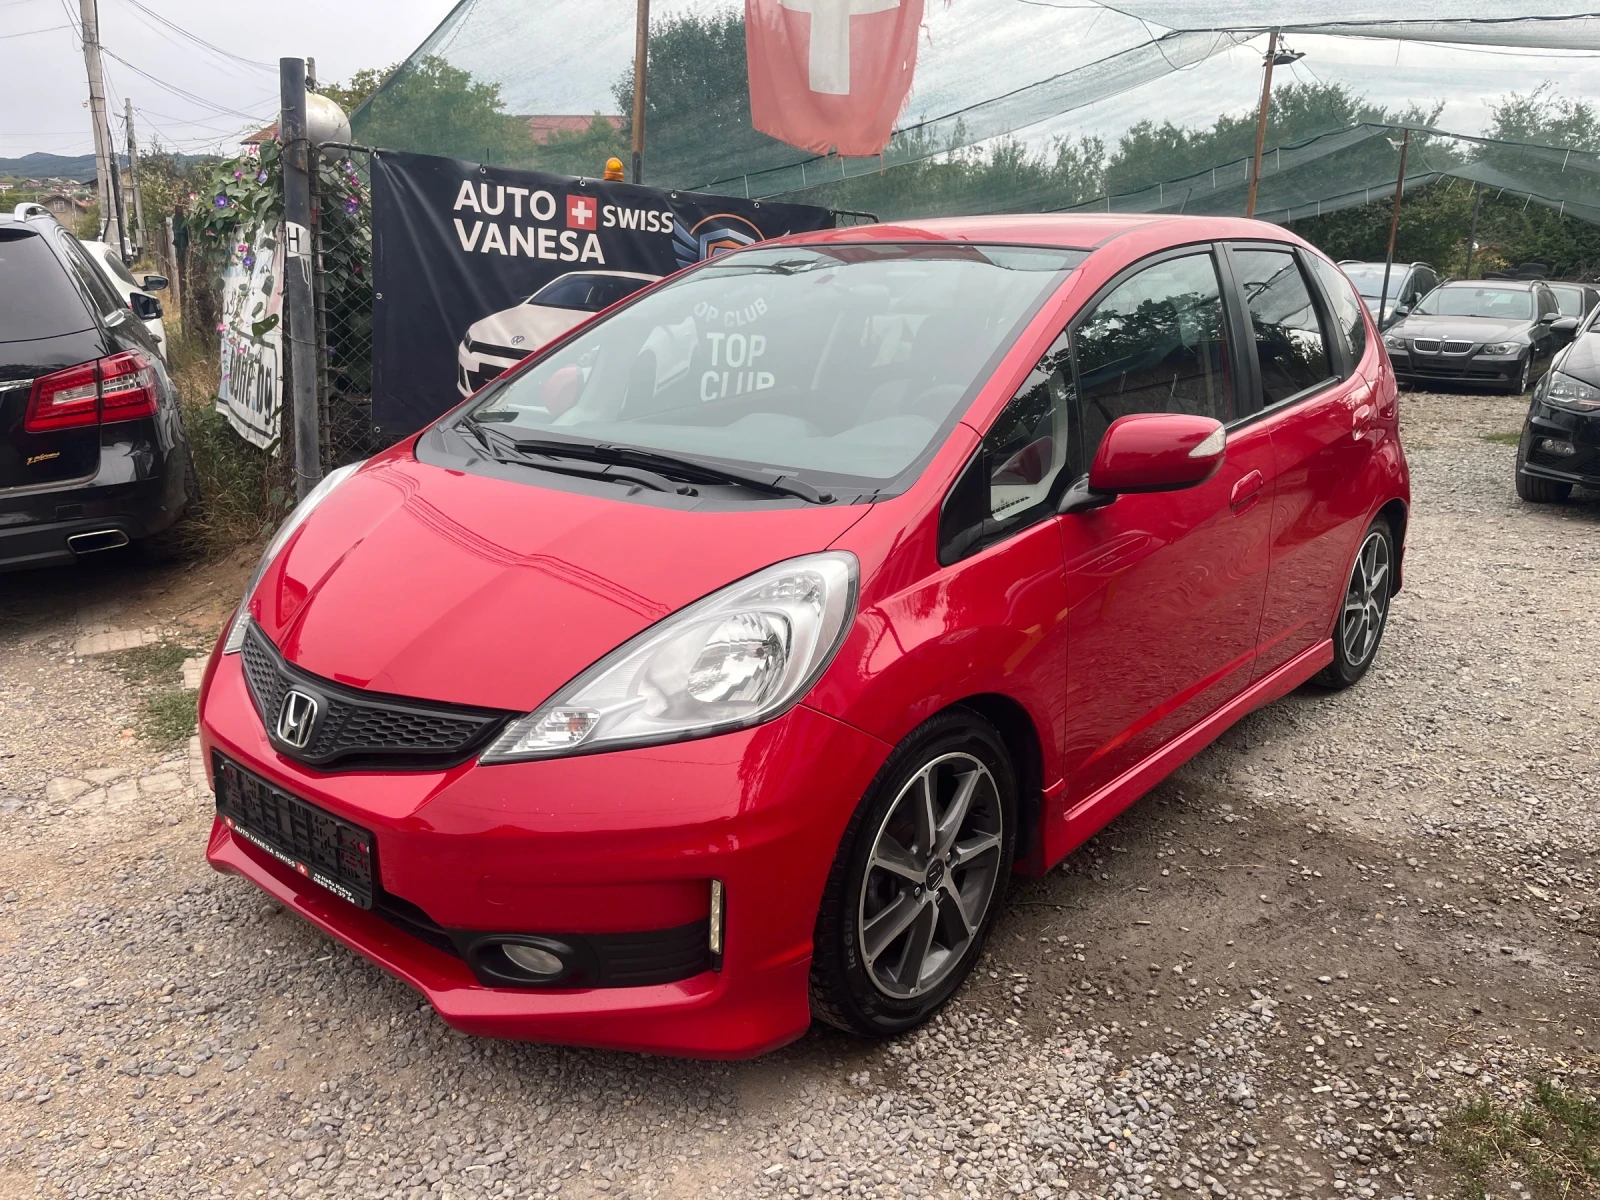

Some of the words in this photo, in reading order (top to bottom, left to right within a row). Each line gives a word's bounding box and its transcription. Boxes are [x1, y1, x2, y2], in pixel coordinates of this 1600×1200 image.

[453, 179, 557, 222] AUTO
[602, 204, 674, 235] SWISS
[453, 218, 606, 265] VANESA
[693, 300, 719, 323] OP
[723, 297, 769, 328] CLUB
[706, 331, 767, 368] TOP
[234, 825, 250, 838] AUTO
[250, 834, 275, 855] VANESA
[275, 850, 296, 868] SWISS
